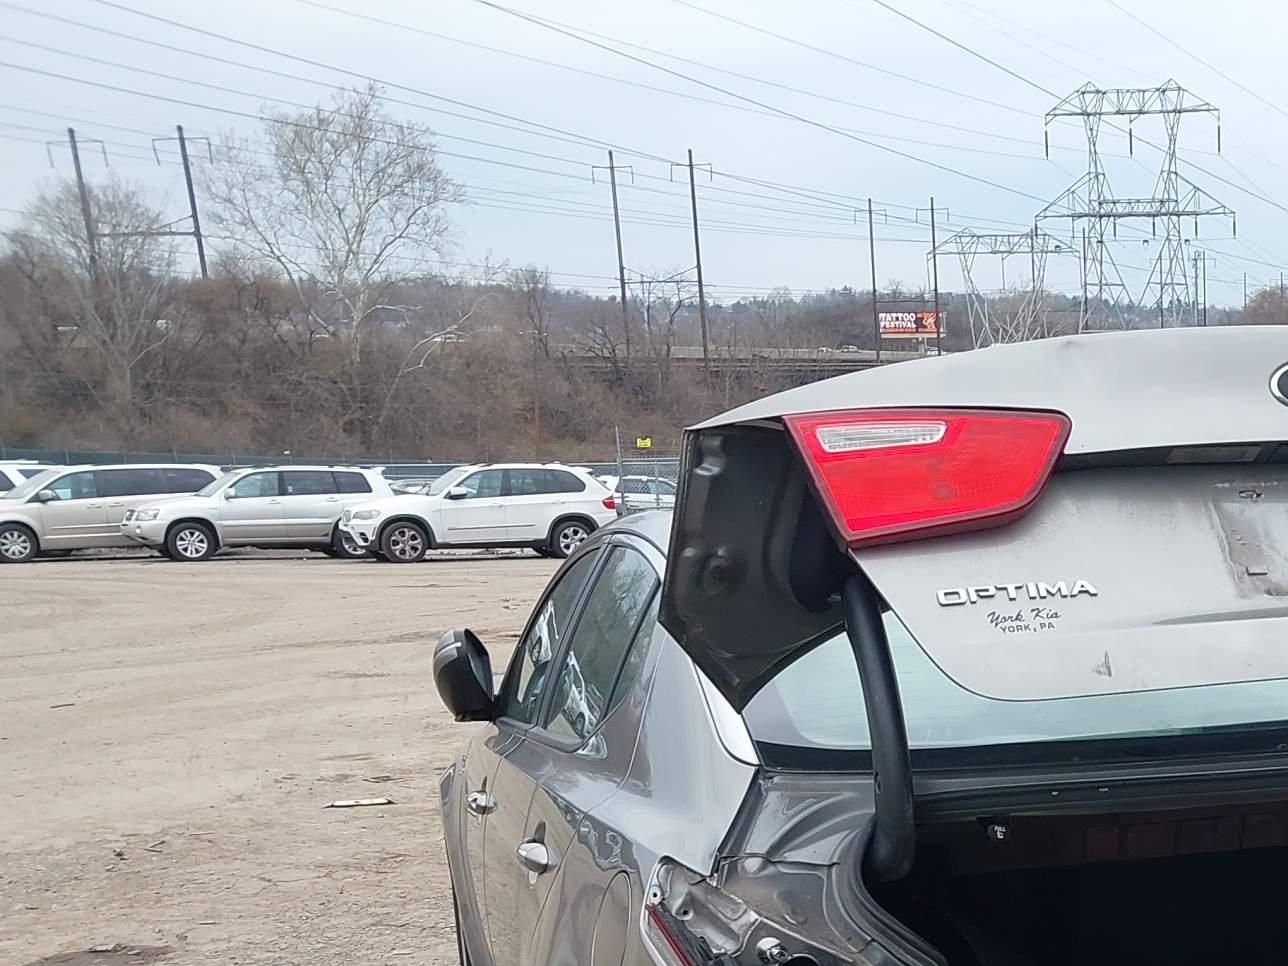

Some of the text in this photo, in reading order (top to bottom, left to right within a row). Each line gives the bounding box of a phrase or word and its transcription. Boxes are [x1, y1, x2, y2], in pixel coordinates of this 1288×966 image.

[879, 312, 916, 321] TATTOO
[936, 579, 1099, 607] OPTIMA
[987, 607, 1061, 628] York Kia
[1000, 621, 1055, 632] YORK, PA
